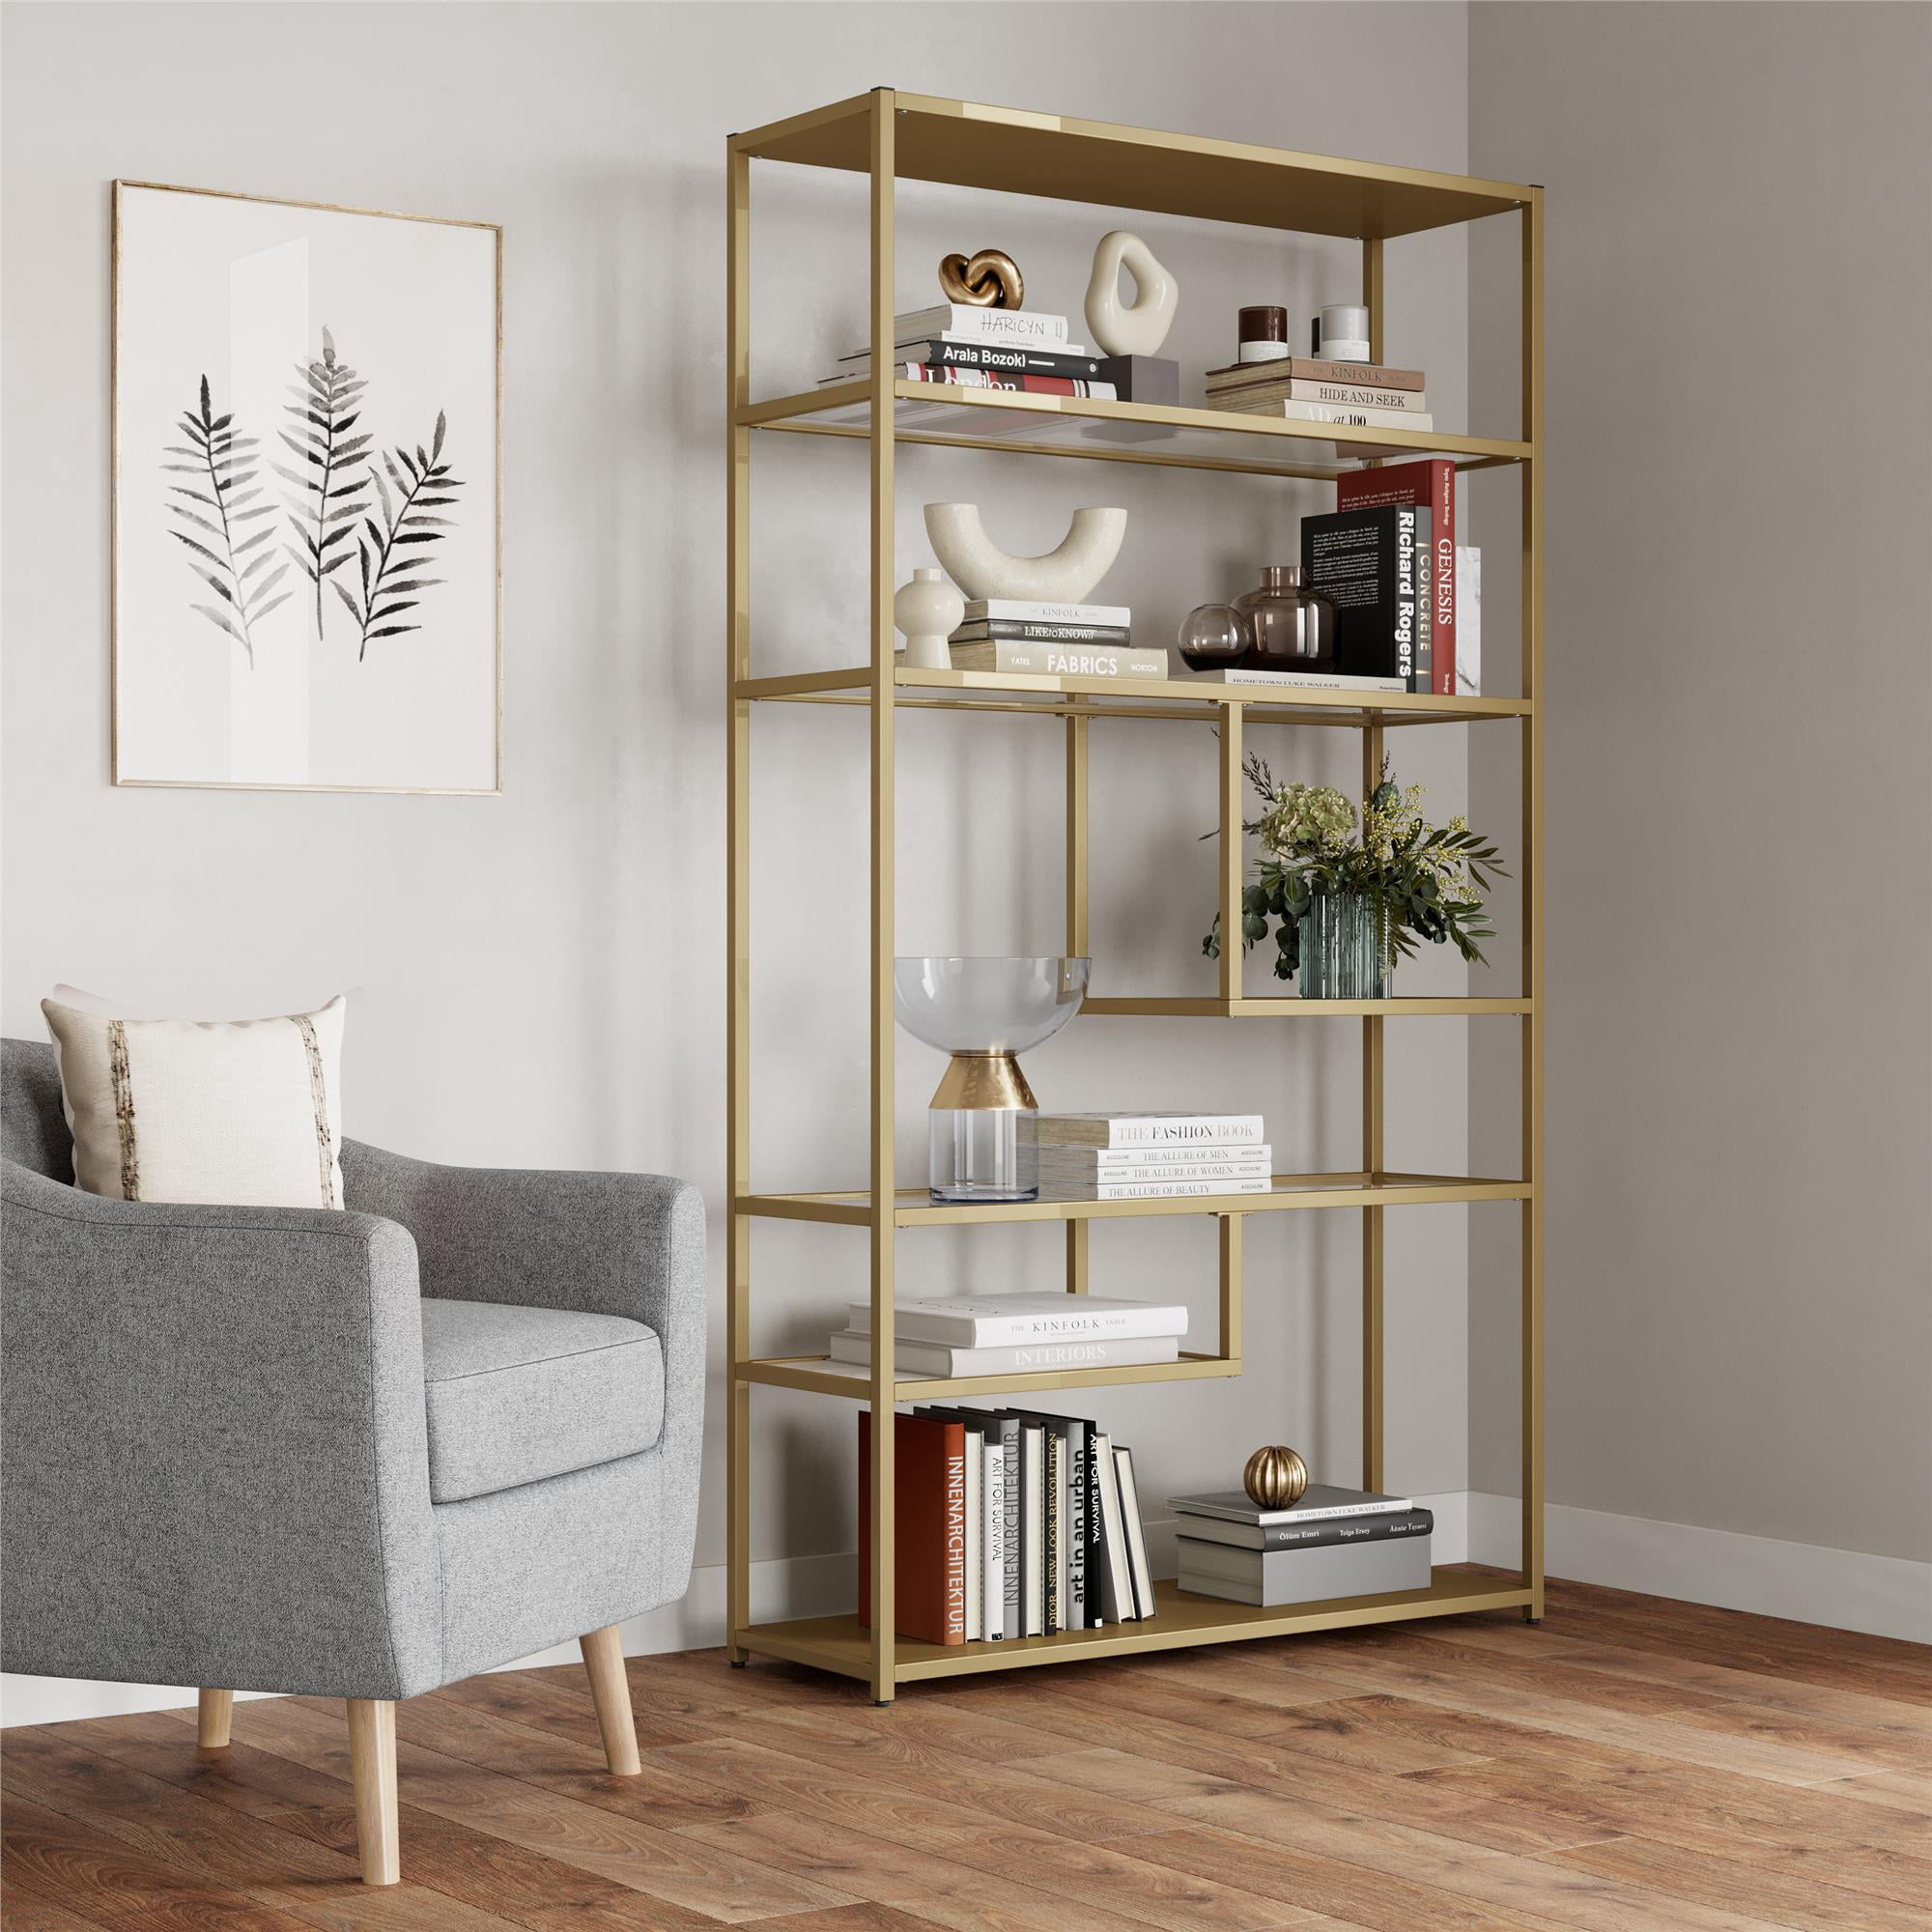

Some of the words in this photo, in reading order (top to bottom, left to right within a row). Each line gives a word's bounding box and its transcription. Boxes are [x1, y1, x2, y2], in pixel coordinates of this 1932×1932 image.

[943, 346, 978, 363] Arala
[1331, 366, 1382, 383] KINFOLK
[1320, 387, 1348, 402] HIDE
[1350, 391, 1374, 404] AND
[1376, 394, 1406, 408] SEEK
[1333, 414, 1345, 425] at
[1349, 413, 1367, 427] 100
[1399, 512, 1414, 595] Richard
[1438, 538, 1453, 625] GENESIS
[1420, 554, 1431, 651] CONCRETE
[1042, 609, 1081, 618] KINFOLK
[1394, 601, 1414, 677] Rogers
[1011, 657, 1030, 666] YATES
[1047, 654, 1118, 675] FABRICS
[1130, 664, 1157, 673] NORTON
[1118, 1127, 1149, 1141] THE
[1151, 1124, 1213, 1140] FASHION
[1217, 1123, 1253, 1137] BOOK
[1144, 1152, 1159, 1161] THE
[1161, 1151, 1196, 1160] ALLURE
[1197, 1151, 1208, 1159] OF
[1209, 1150, 1229, 1159] MEN
[1134, 1169, 1150, 1178] THE
[1151, 1167, 1185, 1177] ALLURE
[1187, 1167, 1199, 1176] OF
[1200, 1166, 1234, 1176] WOMEN
[1108, 1188, 1125, 1197] THE
[1126, 1186, 1159, 1196] ALLURE
[1162, 1185, 1175, 1195] OF
[1176, 1184, 1210, 1194] BEAUTY
[1033, 1319, 1100, 1332] KINFOLK
[1013, 1344, 1106, 1365] INTERIORS
[992, 1457, 1003, 1480] ART
[1069, 1450, 1084, 1511] urban
[992, 1483, 1003, 1506] FOR
[1004, 1432, 1019, 1606] INNENARCHITEKTUR
[1092, 1489, 1100, 1543] SURVIVAL
[1296, 1509, 1338, 1519] HOMETOWN
[1358, 1505, 1386, 1514] WALKER
[992, 1510, 1003, 1561] SURVIVAL
[1074, 1517, 1084, 1542] an
[948, 1456, 963, 1634] INNENARCHITEKTUR
[1069, 1547, 1084, 1568] in
[1071, 1575, 1084, 1604] art
